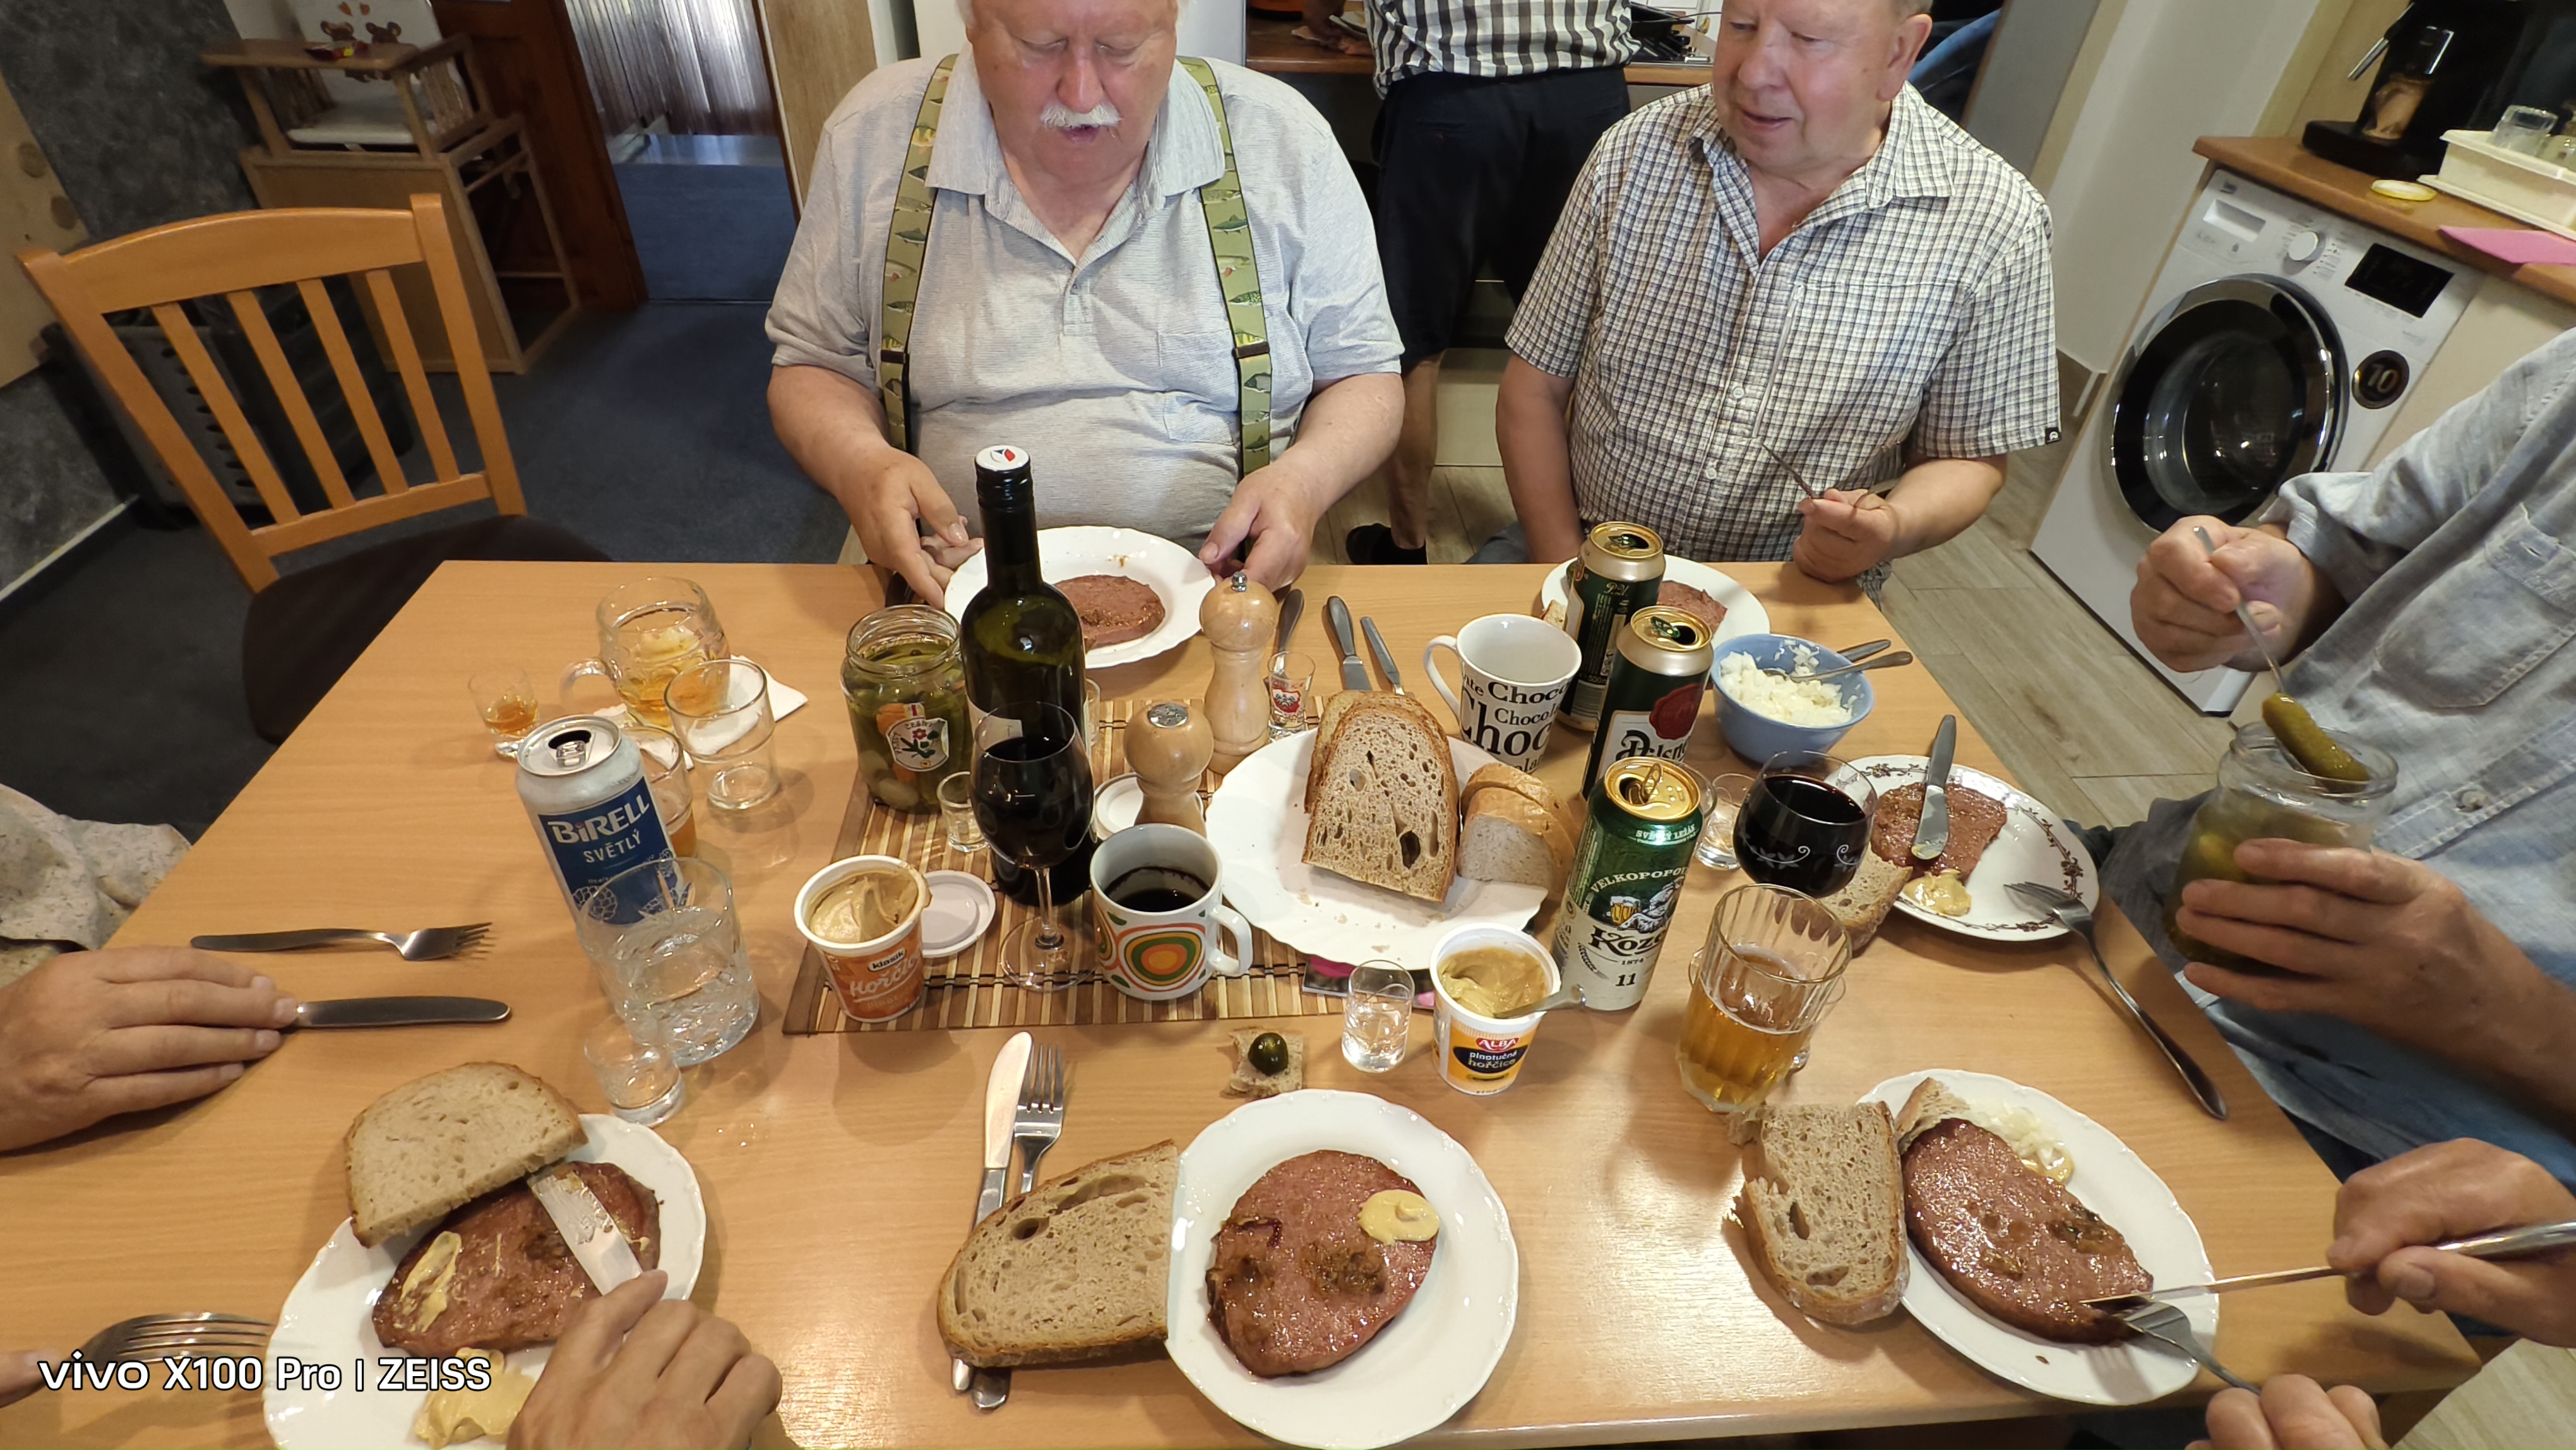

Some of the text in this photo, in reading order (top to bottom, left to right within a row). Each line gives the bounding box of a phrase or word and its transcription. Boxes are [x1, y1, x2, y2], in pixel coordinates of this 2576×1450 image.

[2368, 363, 2399, 393] 10
[1635, 829, 1673, 841] SVĚÝ
[583, 829, 641, 863] SVĚTLÝ
[873, 950, 904, 969] klasik
[1621, 957, 1644, 966] 1874
[1615, 973, 1637, 986] 11
[1478, 1039, 1517, 1051] ALBA
